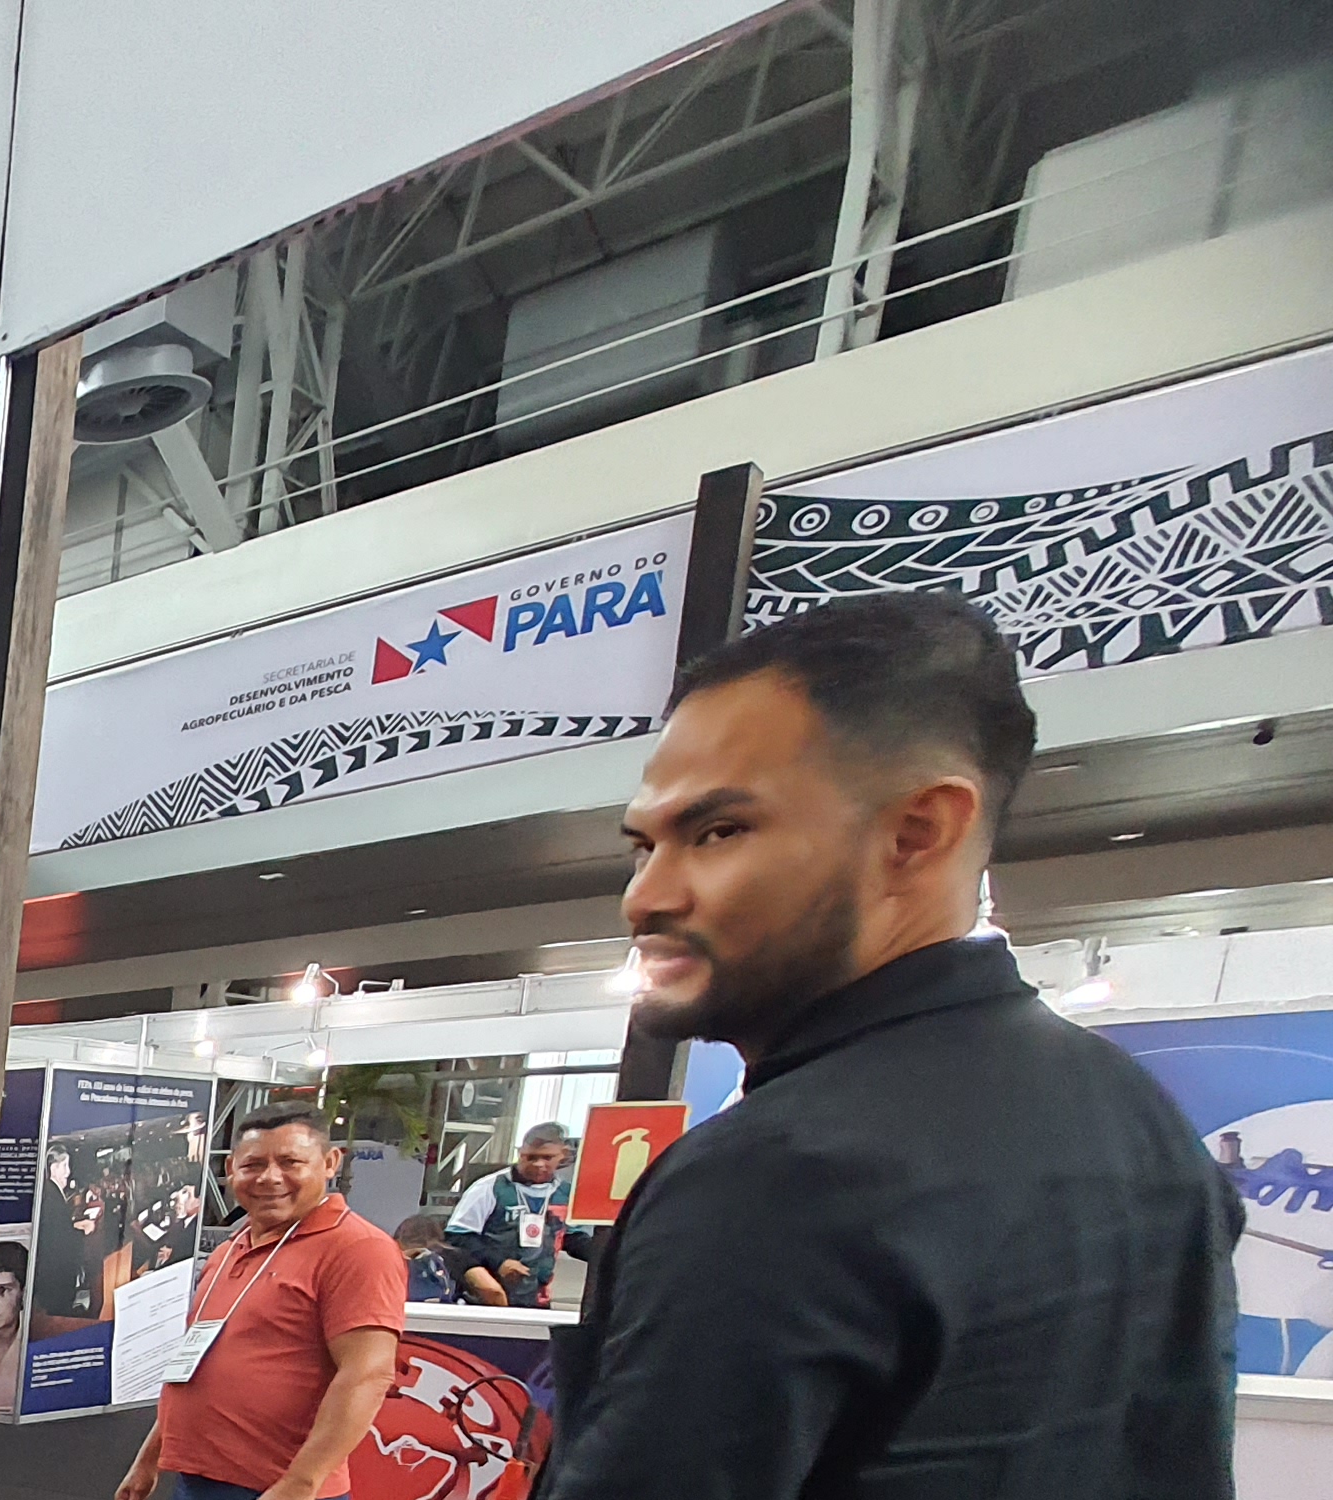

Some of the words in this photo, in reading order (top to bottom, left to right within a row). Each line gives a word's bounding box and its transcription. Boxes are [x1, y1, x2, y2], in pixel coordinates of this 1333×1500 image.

[510, 563, 622, 601] GOVERNO
[634, 552, 668, 571] DO
[503, 570, 667, 653] PARÁ
[229, 666, 354, 706] DESENVOLVIMENTO
[263, 657, 334, 685] SECRETARIA
[338, 651, 356, 665] DE
[181, 701, 276, 732] AGROPECUÁRIO
[278, 697, 286, 707] E
[289, 693, 307, 706] DA
[310, 682, 352, 700] PESCA
